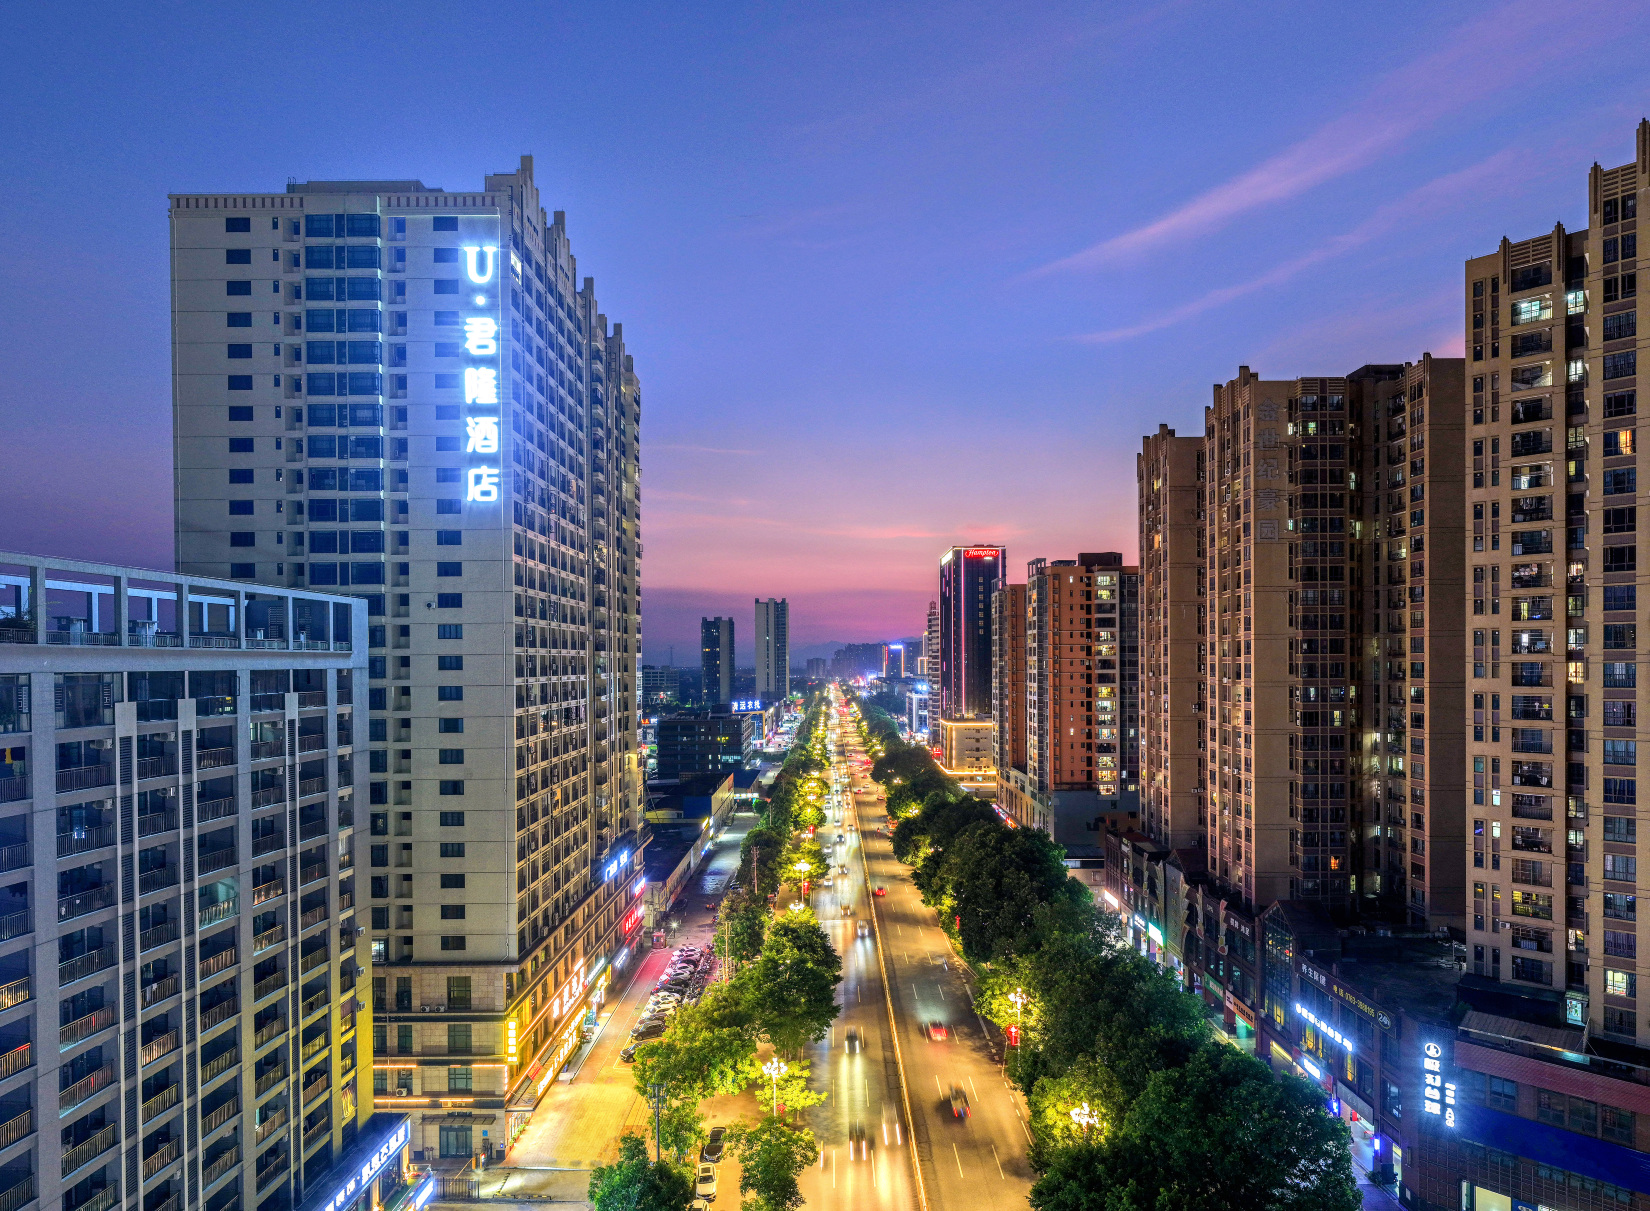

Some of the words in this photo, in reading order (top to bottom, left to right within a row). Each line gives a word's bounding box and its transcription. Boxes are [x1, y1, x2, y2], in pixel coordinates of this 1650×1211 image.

[1257, 397, 1281, 542] 金世纪豪园
[965, 549, 999, 558] Hampton
